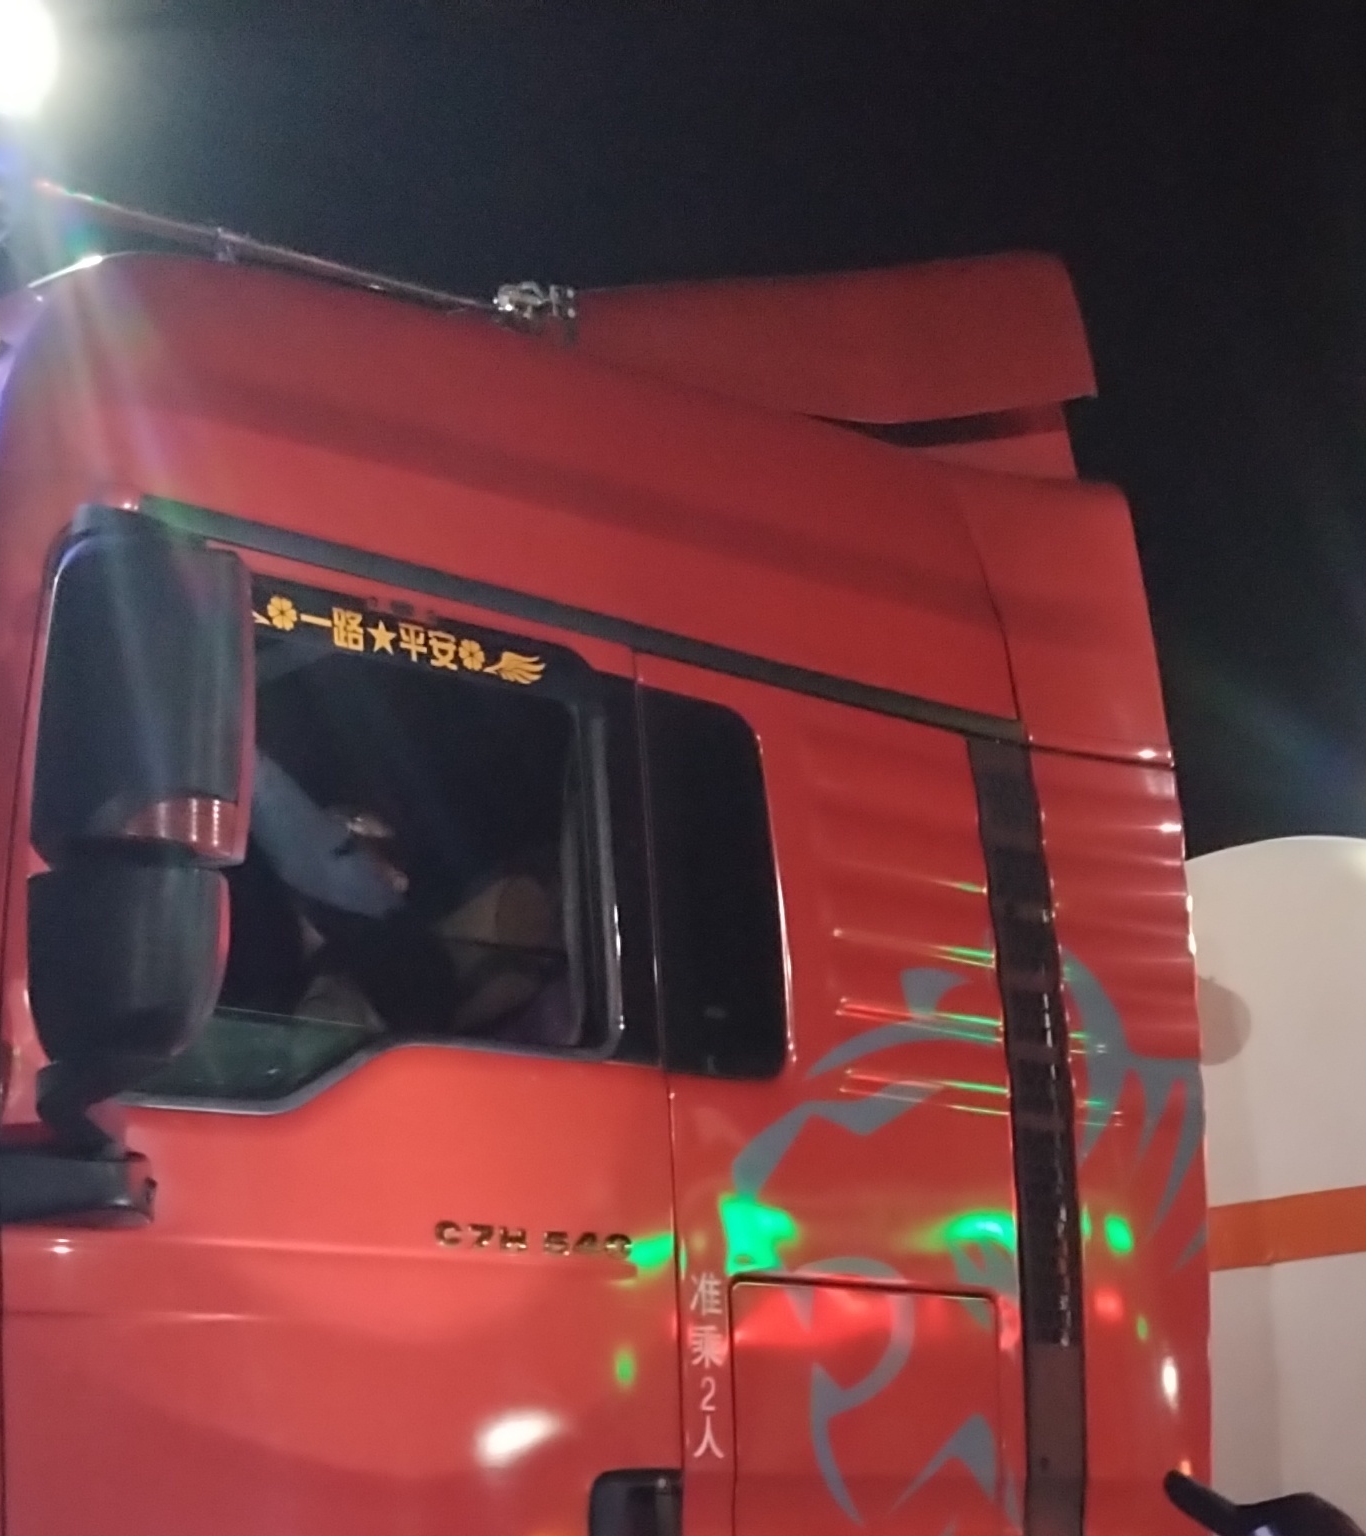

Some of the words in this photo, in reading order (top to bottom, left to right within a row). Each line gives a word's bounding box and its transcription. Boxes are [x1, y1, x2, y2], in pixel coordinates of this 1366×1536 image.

[398, 621, 459, 670] 平安
[434, 1219, 529, 1256] C7H
[689, 1271, 726, 1462] 准乘2人
